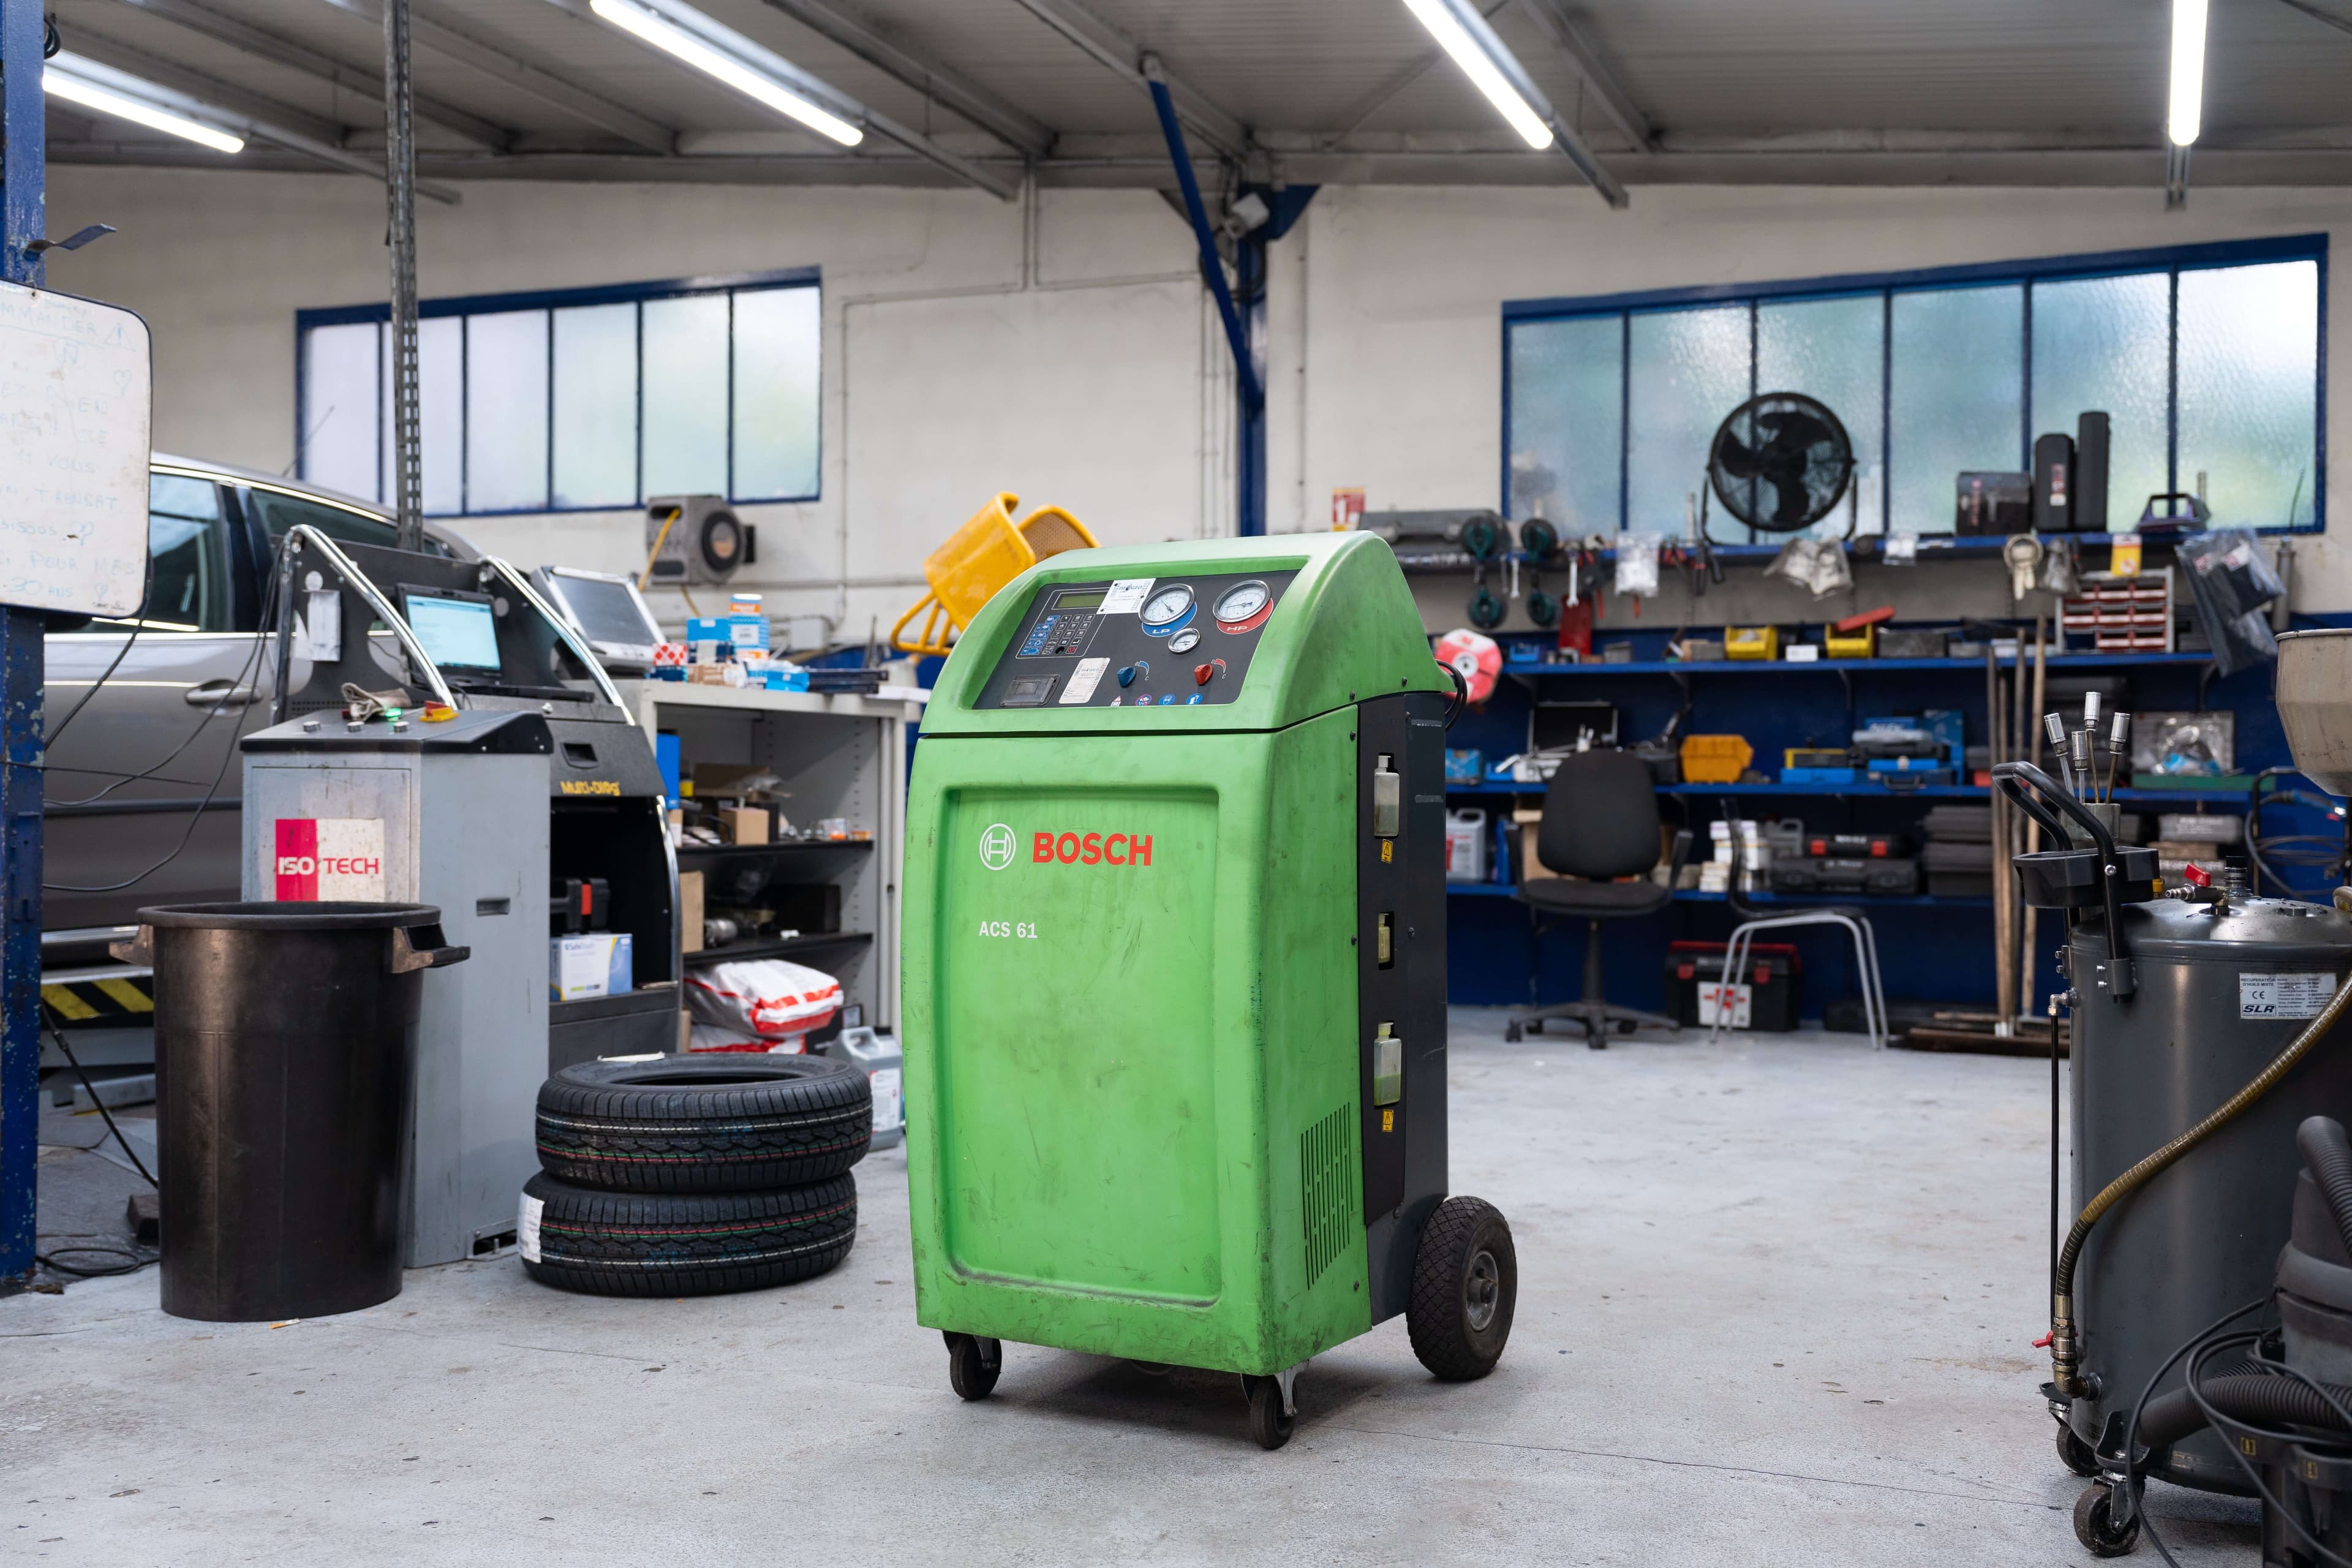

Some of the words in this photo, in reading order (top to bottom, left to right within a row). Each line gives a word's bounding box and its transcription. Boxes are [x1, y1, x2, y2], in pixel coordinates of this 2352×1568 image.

[1033, 832, 1153, 866] BOSCH
[277, 856, 315, 875] ISO
[323, 858, 379, 875] TECH
[979, 921, 1011, 938] ACS
[1017, 922, 1038, 938] 61
